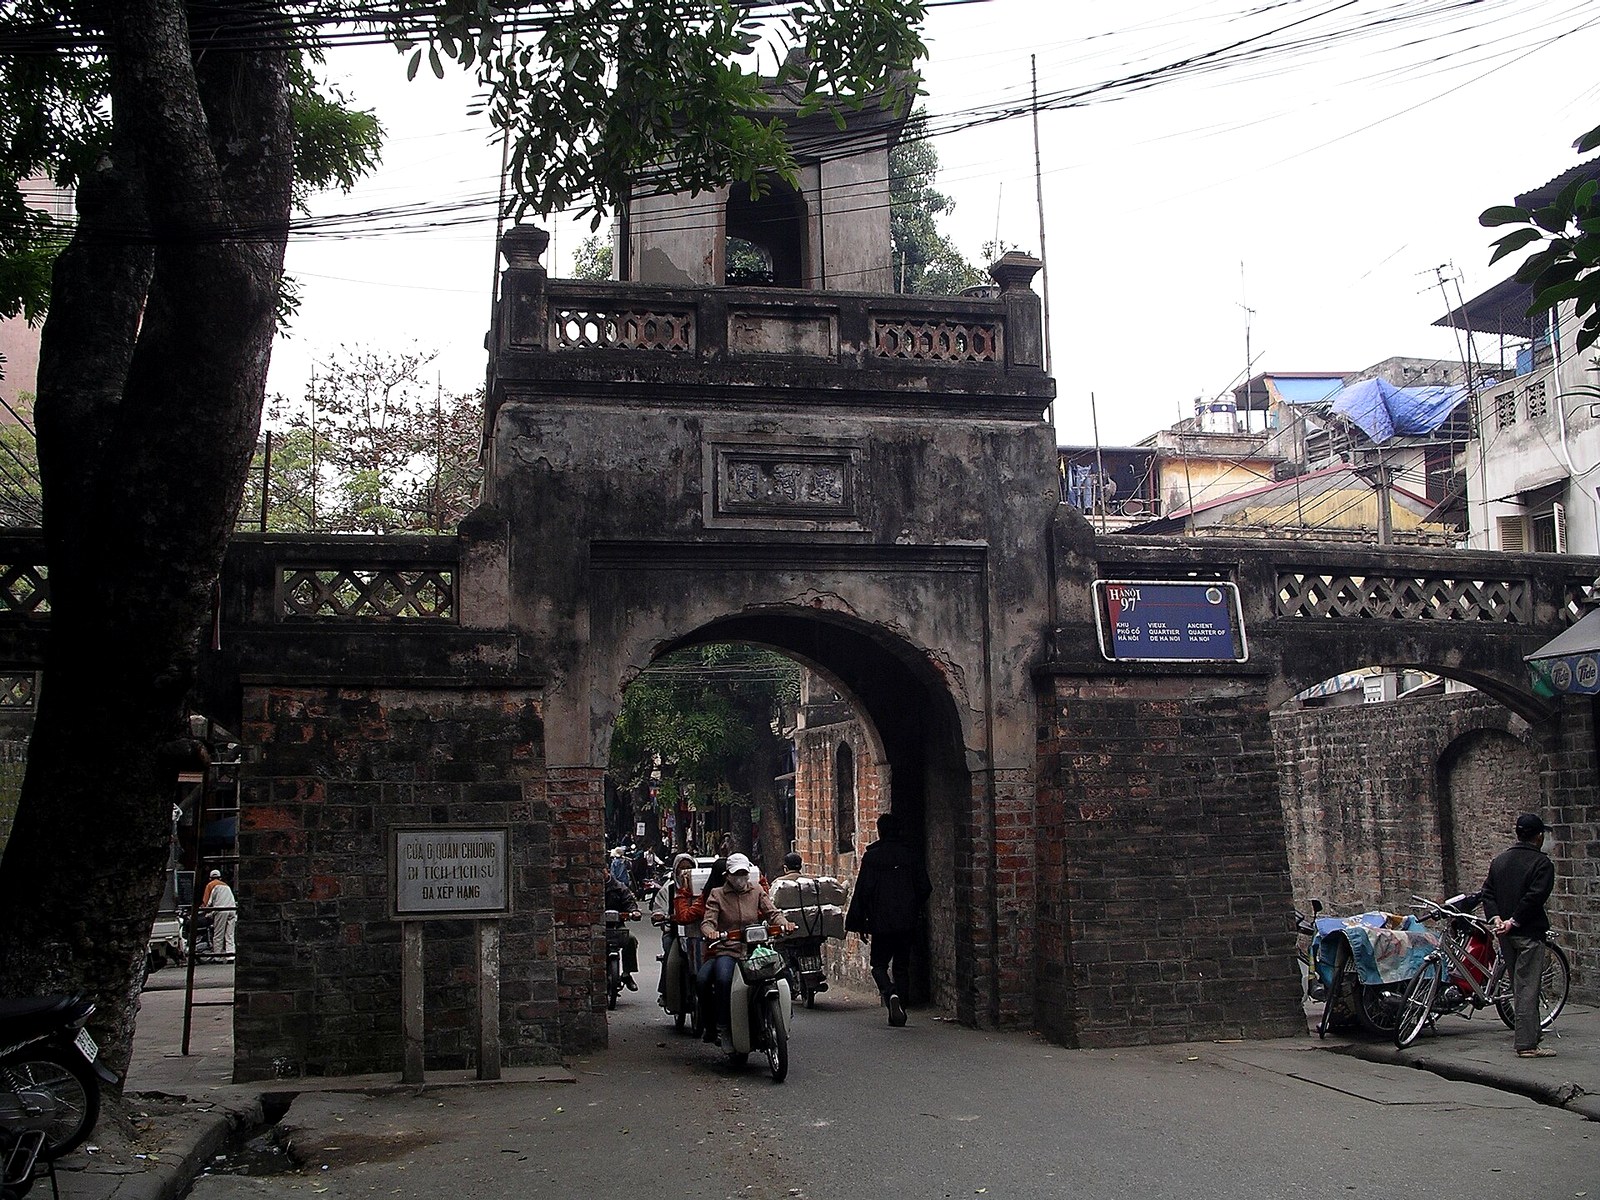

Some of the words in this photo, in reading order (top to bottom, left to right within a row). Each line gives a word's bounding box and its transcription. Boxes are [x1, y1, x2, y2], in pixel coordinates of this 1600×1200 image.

[1120, 598, 1136, 611] 97
[1552, 667, 1570, 685] Tide
[1578, 664, 1597, 683] Tide
[436, 842, 459, 861] QUAN
